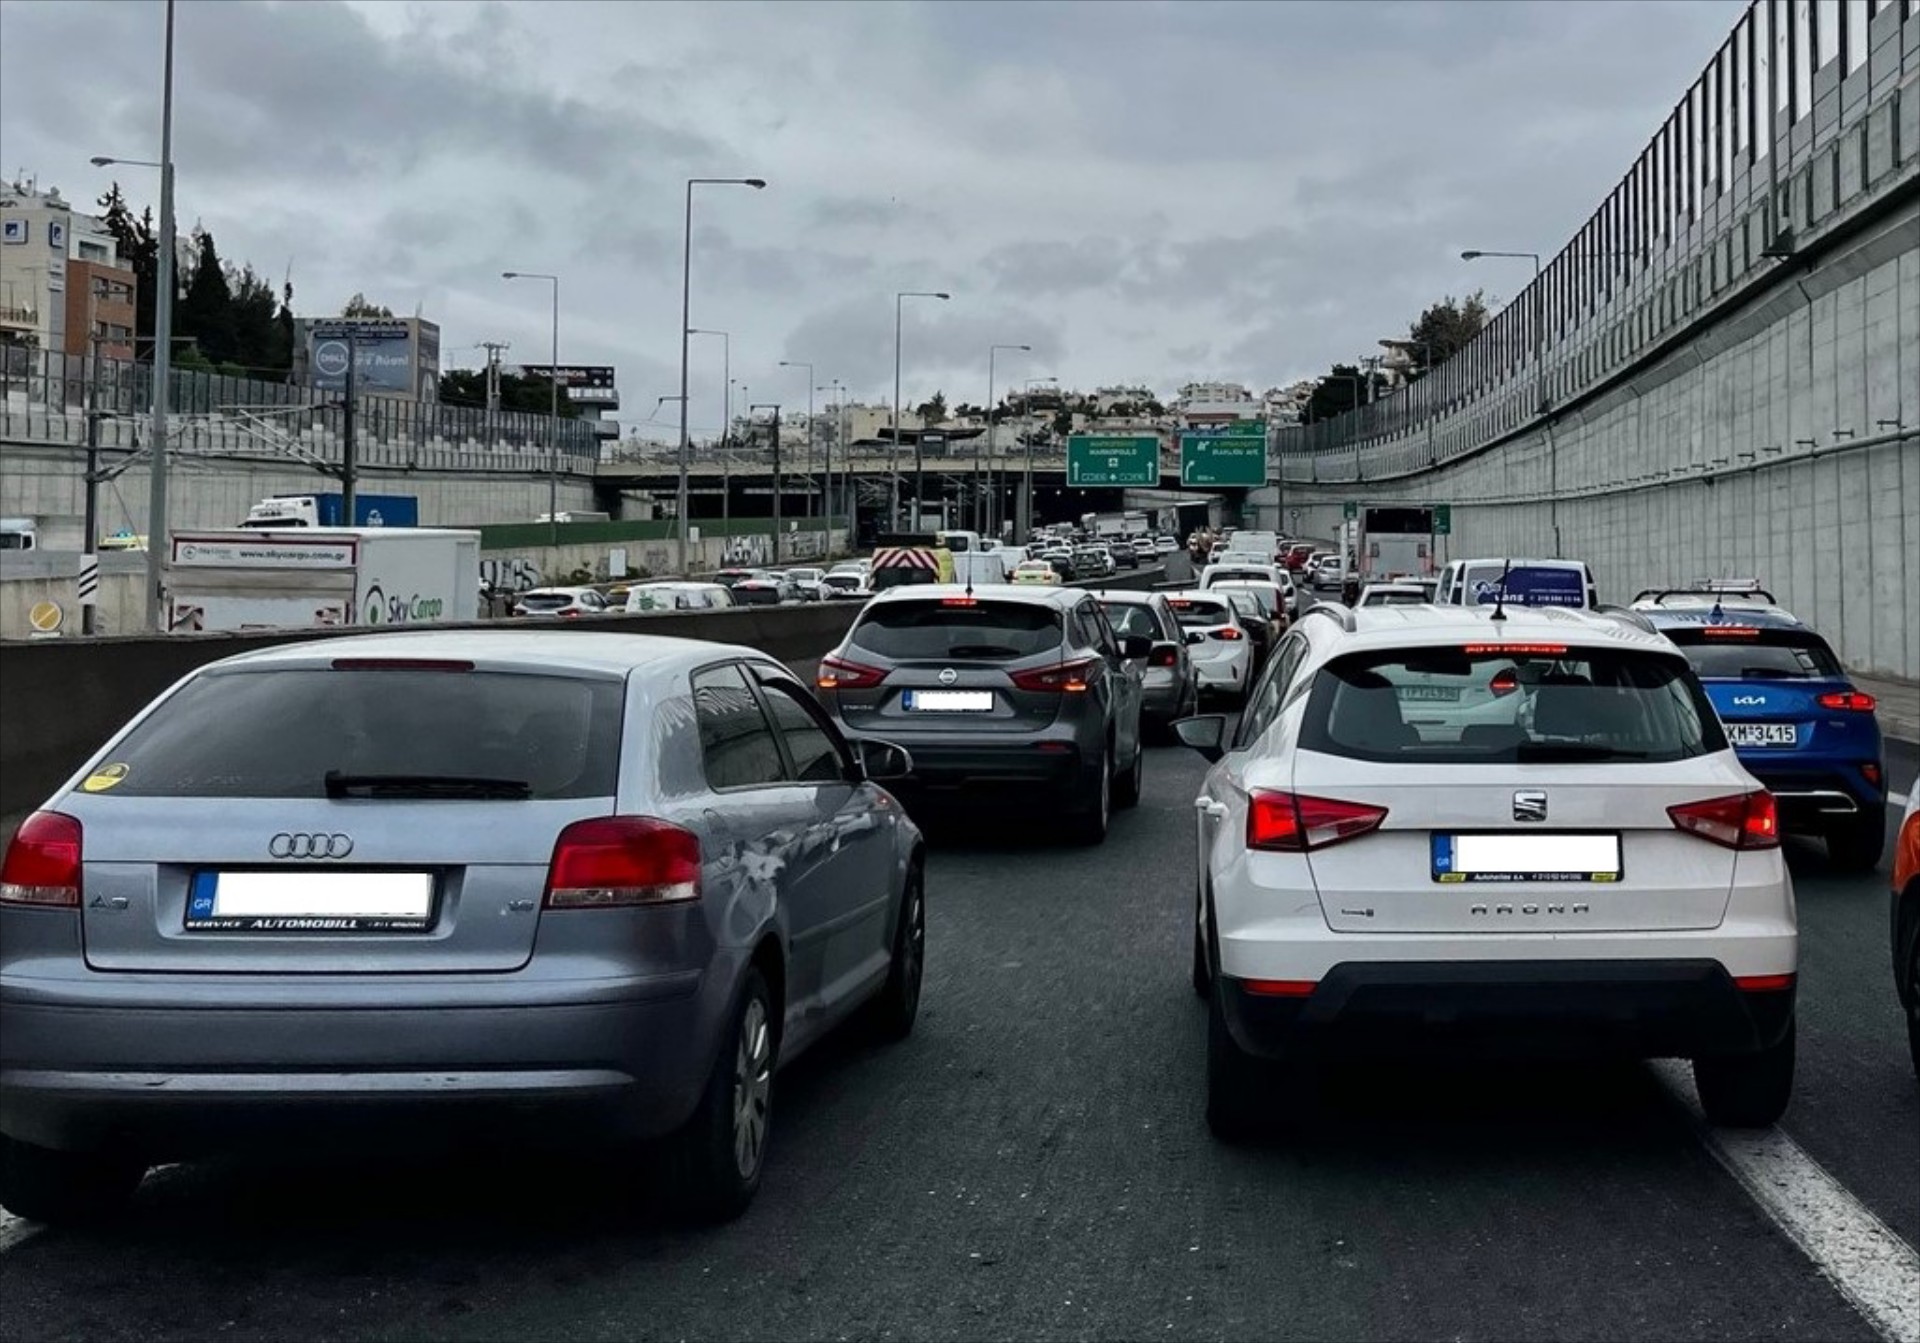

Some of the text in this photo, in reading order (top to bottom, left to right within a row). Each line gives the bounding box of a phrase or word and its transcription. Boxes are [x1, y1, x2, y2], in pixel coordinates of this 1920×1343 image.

[194, 899, 212, 909] GR
[1471, 903, 1589, 915] ARONA
[250, 919, 359, 929] AUTOMOBILL
